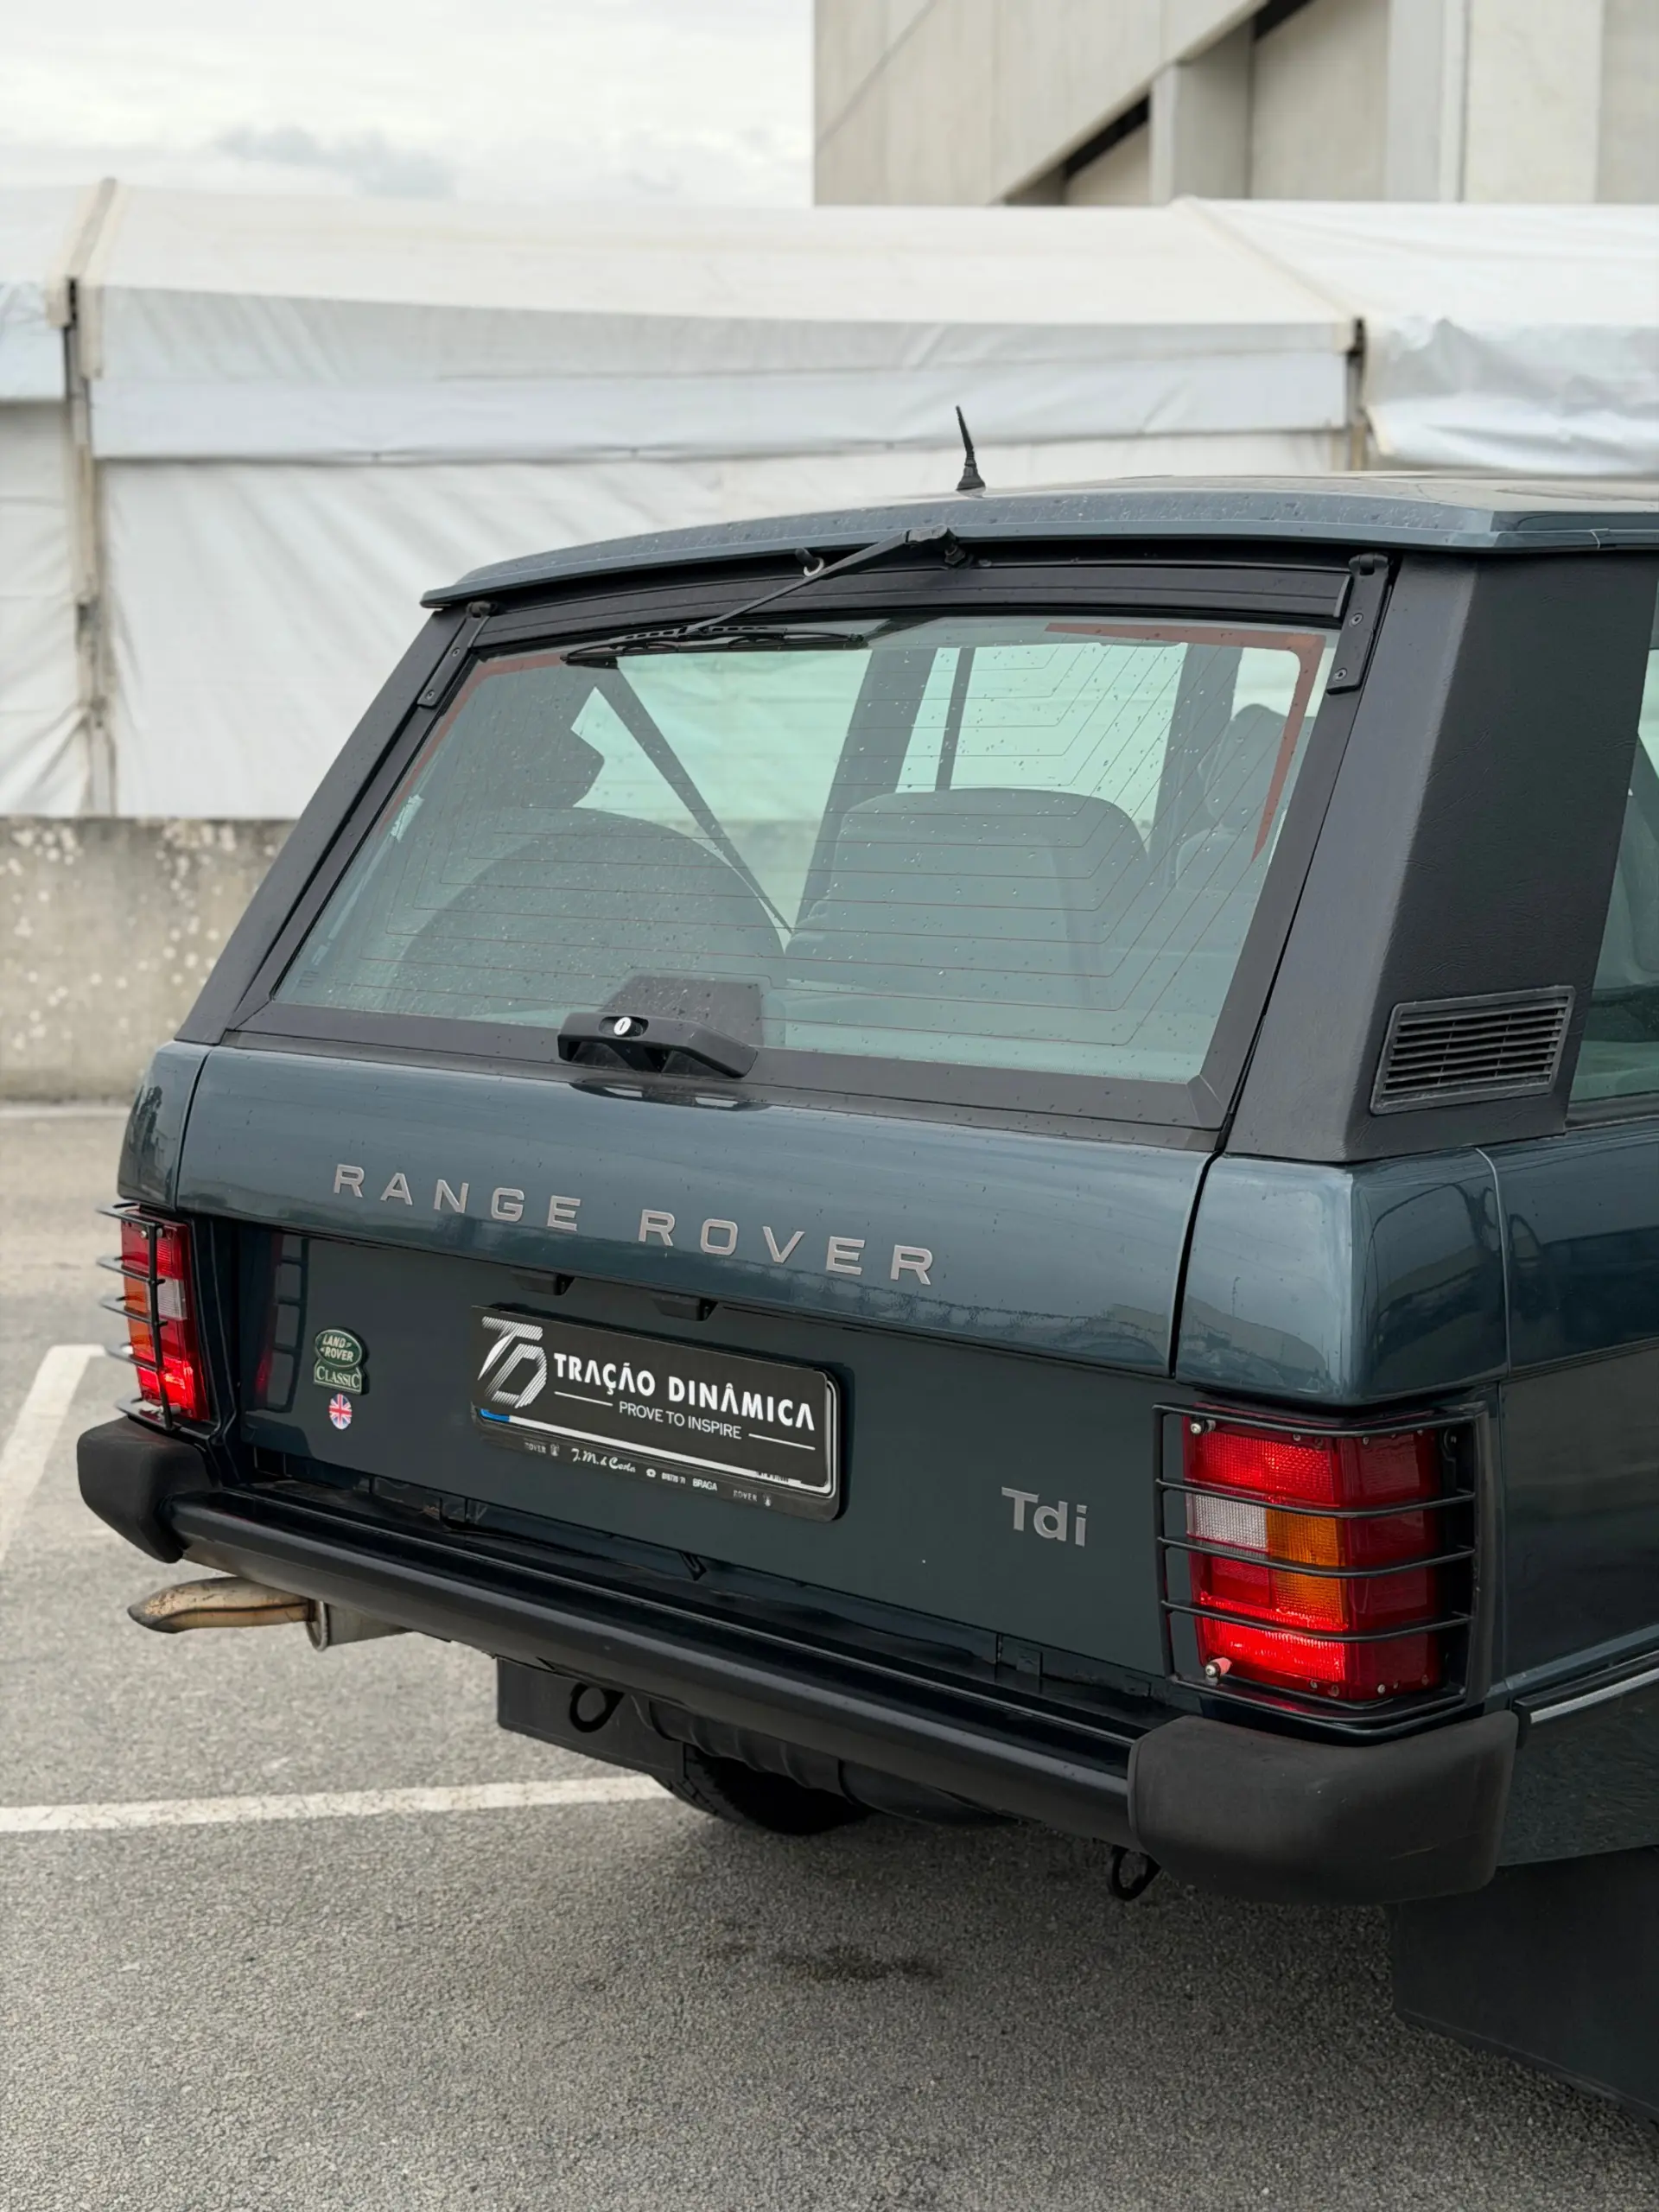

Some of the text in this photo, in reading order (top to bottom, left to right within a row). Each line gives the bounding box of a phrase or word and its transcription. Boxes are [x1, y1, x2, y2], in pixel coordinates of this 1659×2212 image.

[334, 1164, 933, 1286] RANGE ROVER
[322, 1334, 346, 1348] LAND
[324, 1348, 353, 1363] ROVER
[554, 1352, 815, 1431] TRAÇÃO DINÂMICA
[619, 1401, 742, 1440] PROVE TO INSPIRE
[692, 1478, 718, 1491] BRAGA
[1001, 1486, 1088, 1548] Tdi
